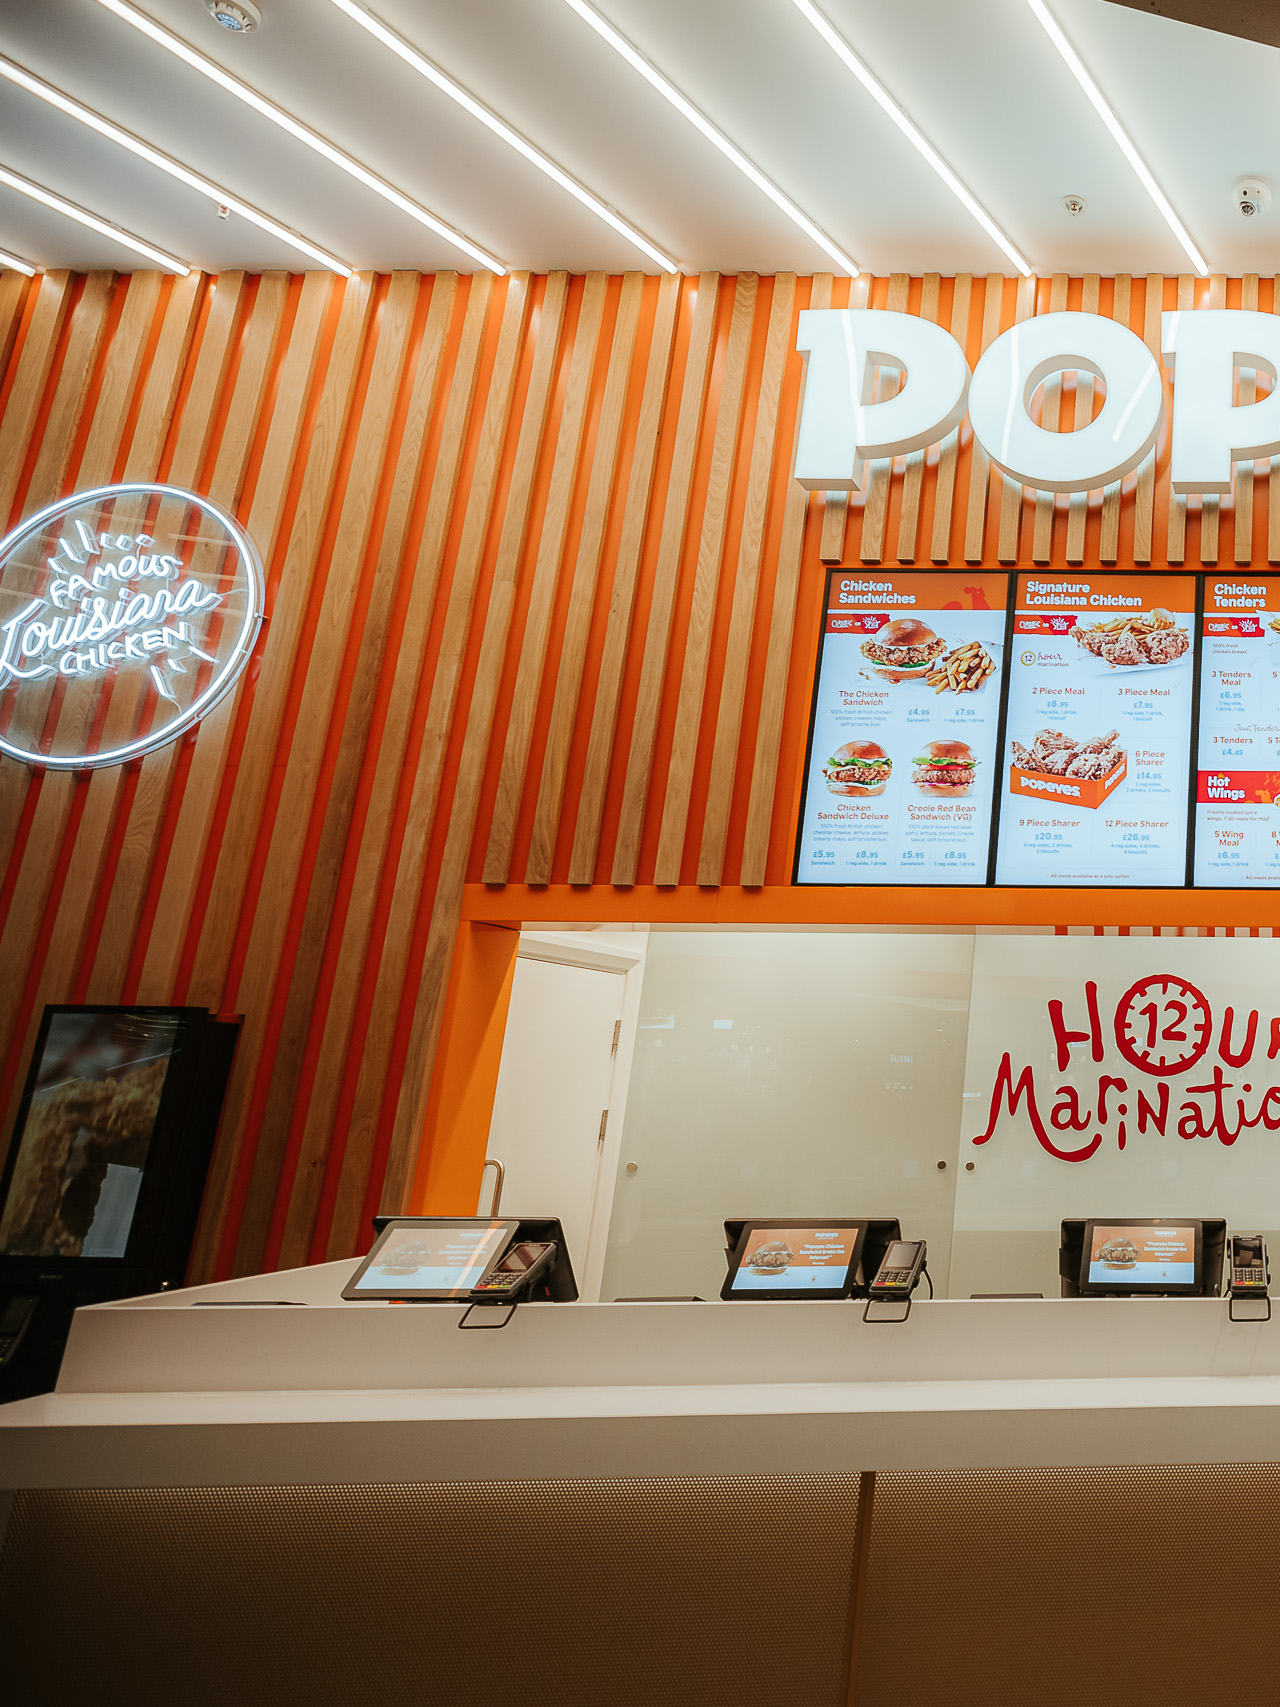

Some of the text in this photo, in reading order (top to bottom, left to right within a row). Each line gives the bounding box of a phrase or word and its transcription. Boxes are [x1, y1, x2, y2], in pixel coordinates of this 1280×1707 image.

[50, 554, 180, 610] FAMOUS
[840, 580, 892, 591] Chicken
[1026, 581, 1090, 595] Signature
[1214, 584, 1267, 595] Chicken
[839, 593, 916, 604] Sandwiches
[1026, 594, 1142, 606] Louisiana Chicken
[1214, 596, 1266, 608] Tenders
[0, 579, 220, 679] Louisiana
[59, 621, 189, 675] CHICKEN
[1037, 652, 1063, 661] hour
[1047, 700, 1069, 708] £6.95
[1207, 776, 1230, 787] Hot
[1207, 788, 1245, 800] Wings
[907, 804, 935, 812] Creole
[817, 812, 859, 820] Sandwich
[910, 813, 972, 821] Sandwich (VG)
[1115, 820, 1138, 828] Piece
[1140, 820, 1168, 828] Sharer
[1222, 831, 1244, 839] Wing
[856, 851, 878, 859] £8.95
[902, 851, 924, 859] £5.95
[1139, 1000, 1187, 1048] 12
